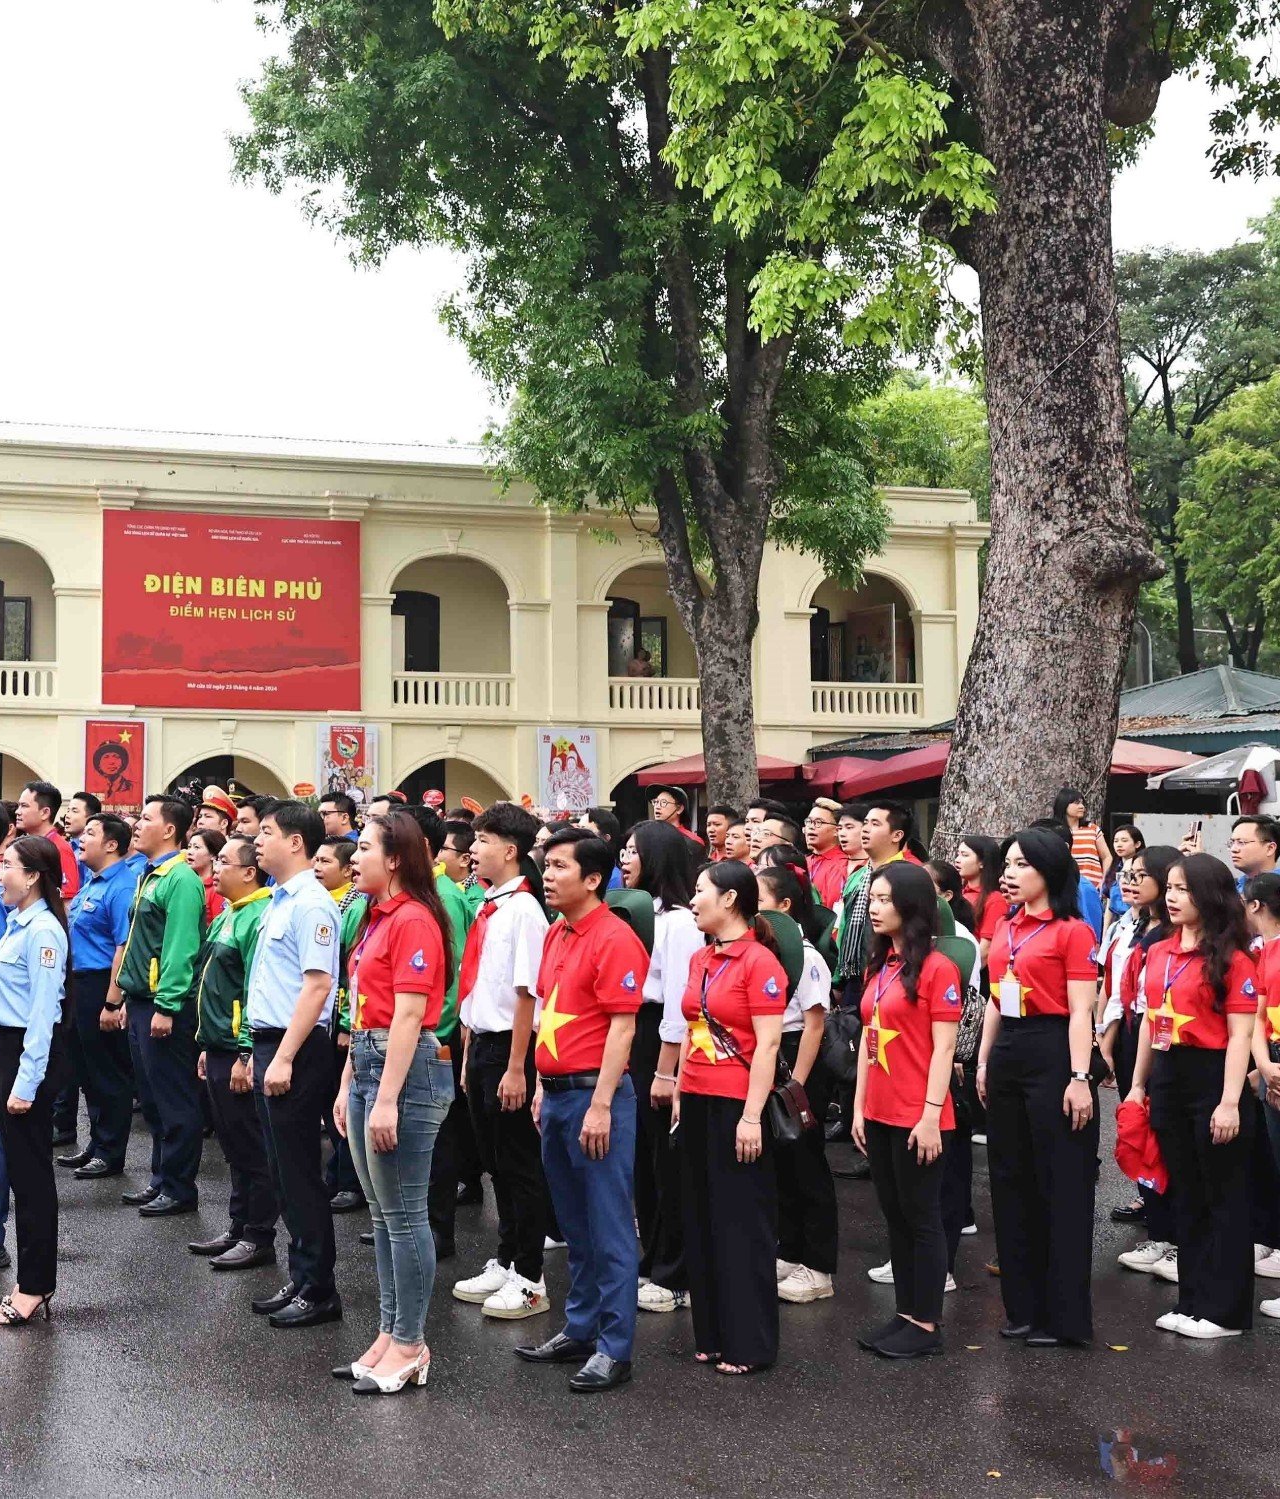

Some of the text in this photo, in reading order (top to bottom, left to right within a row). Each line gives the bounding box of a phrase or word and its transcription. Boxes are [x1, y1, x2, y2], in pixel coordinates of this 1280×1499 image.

[143, 571, 322, 601] ĐIỆN BIÊN PHỦ
[170, 601, 296, 622] ĐIỂM HẸN LỊCH SỬ
